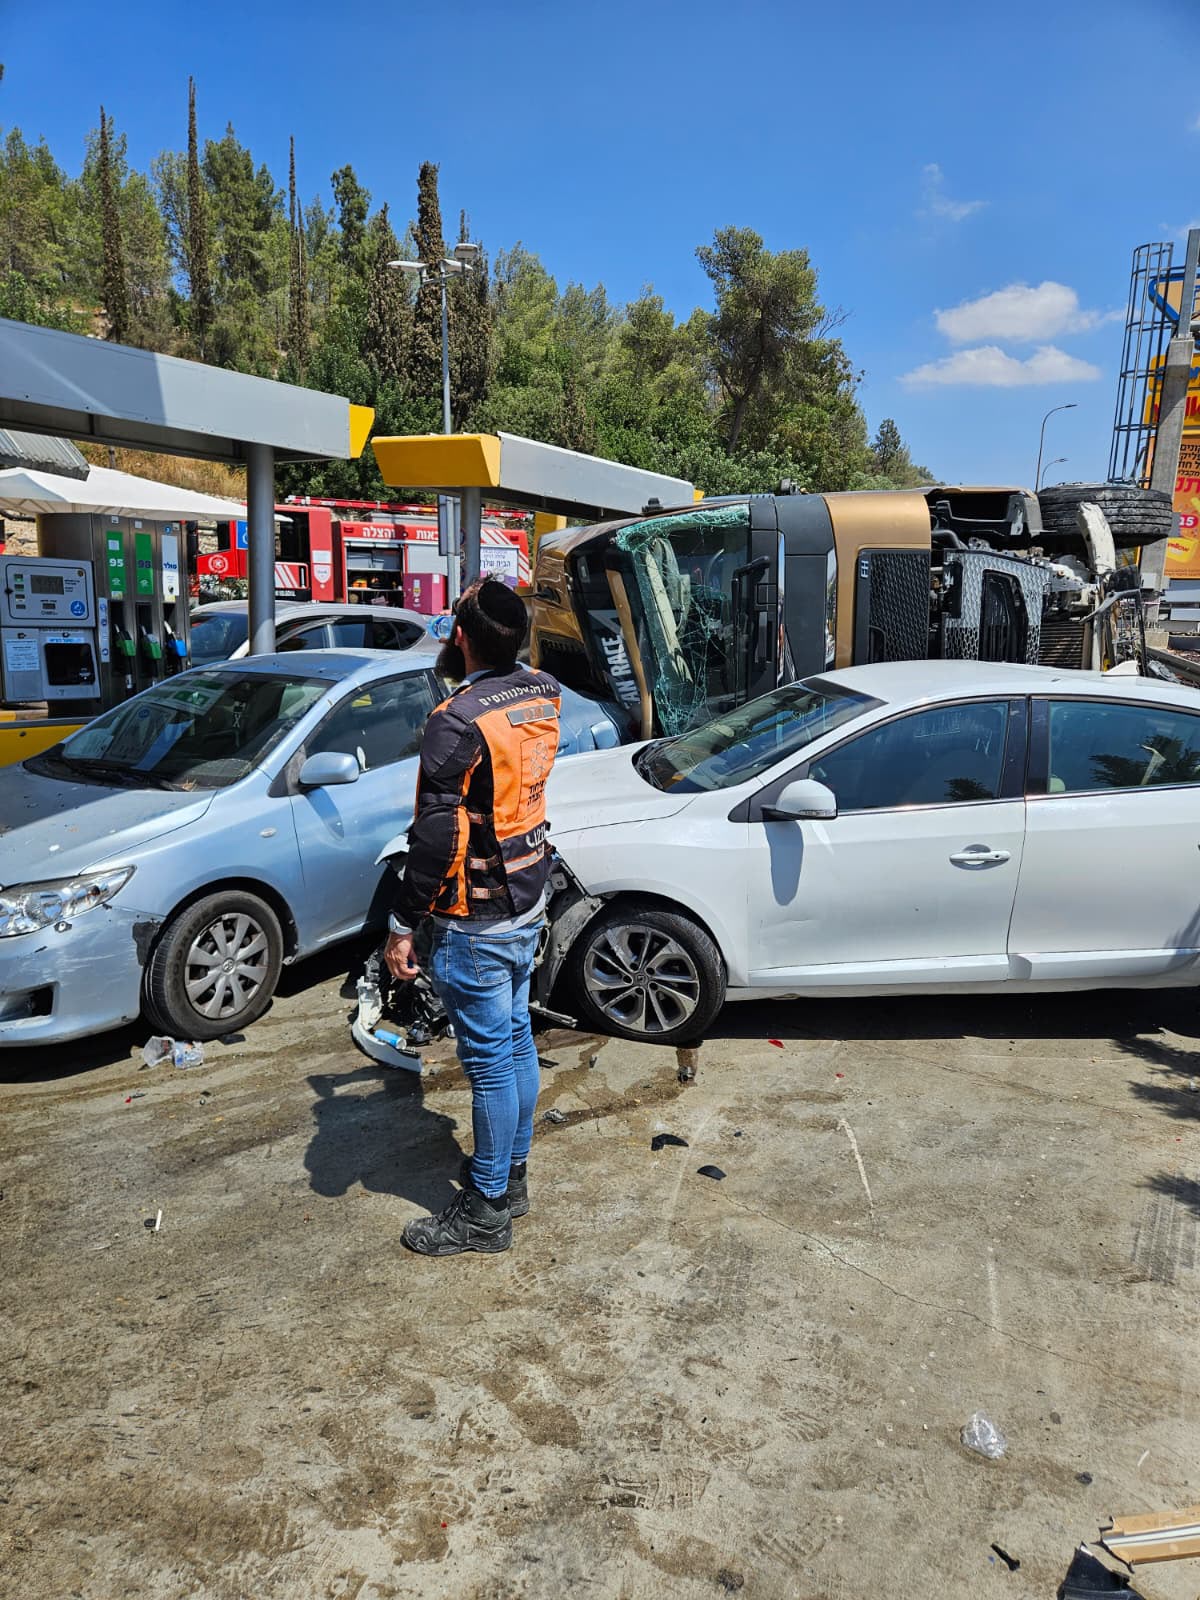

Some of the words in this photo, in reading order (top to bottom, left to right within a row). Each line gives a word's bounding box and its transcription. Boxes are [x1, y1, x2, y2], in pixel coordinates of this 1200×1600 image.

[362, 525, 396, 539] והצלה
[109, 558, 124, 567] 95
[163, 562, 177, 570] סולר
[860, 560, 869, 578] FH
[601, 634, 632, 677] RACE
